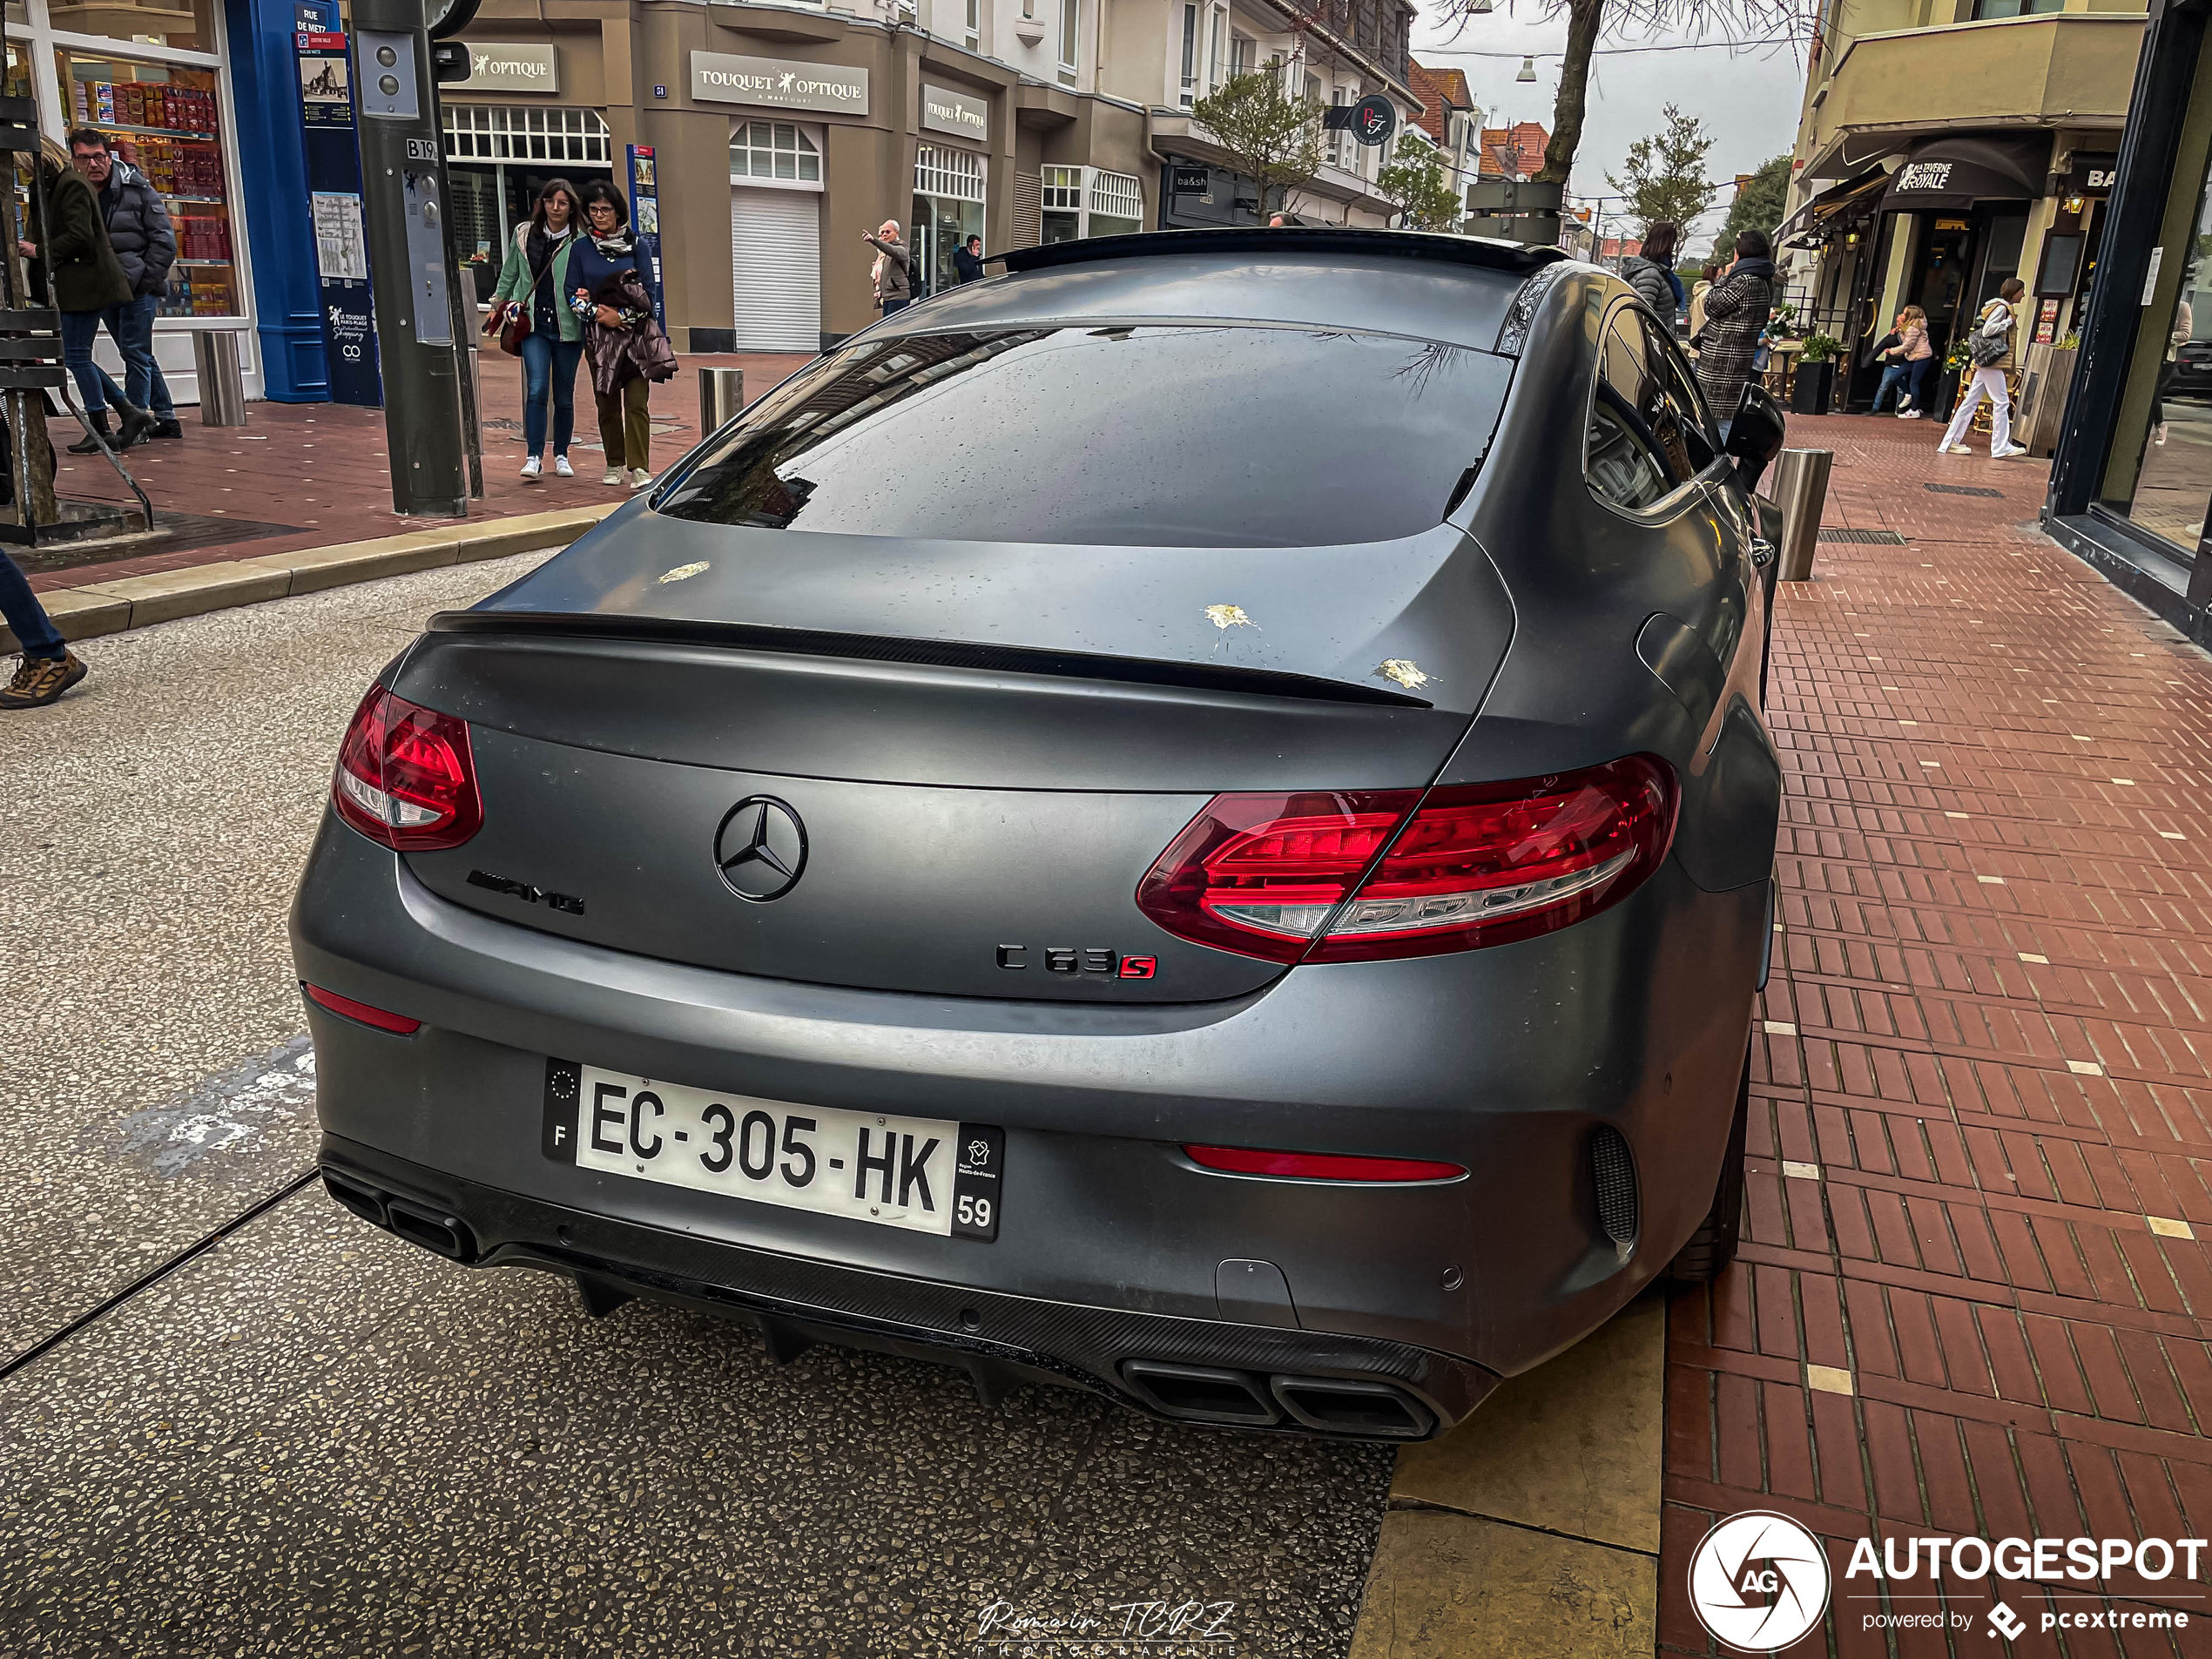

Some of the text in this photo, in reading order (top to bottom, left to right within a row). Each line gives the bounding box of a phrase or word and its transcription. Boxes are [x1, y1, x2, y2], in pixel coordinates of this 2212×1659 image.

[304, 9, 319, 21] RUE
[297, 21, 327, 34] DE METZ
[489, 61, 549, 79] OPTIQUE
[699, 70, 862, 101] TOUQUET OPTIQUE
[927, 102, 985, 129] TOUQUET OPTIQUE
[1352, 129, 1368, 145] HOTEL
[1380, 130, 1392, 142] FOX
[408, 140, 420, 157] B
[1923, 162, 1953, 174] TAVERNE
[1177, 177, 1207, 186] ba&sh
[1907, 172, 1949, 189] ROYALE
[333, 327, 364, 342] Shopping
[496, 876, 584, 916] AMG
[995, 943, 1028, 970] C
[1045, 947, 1117, 973] 63
[554, 1124, 566, 1146] F
[591, 1082, 941, 1213] EC-305-HK
[958, 1168, 996, 1179] Hauts-de-France
[957, 1194, 991, 1228] 59
